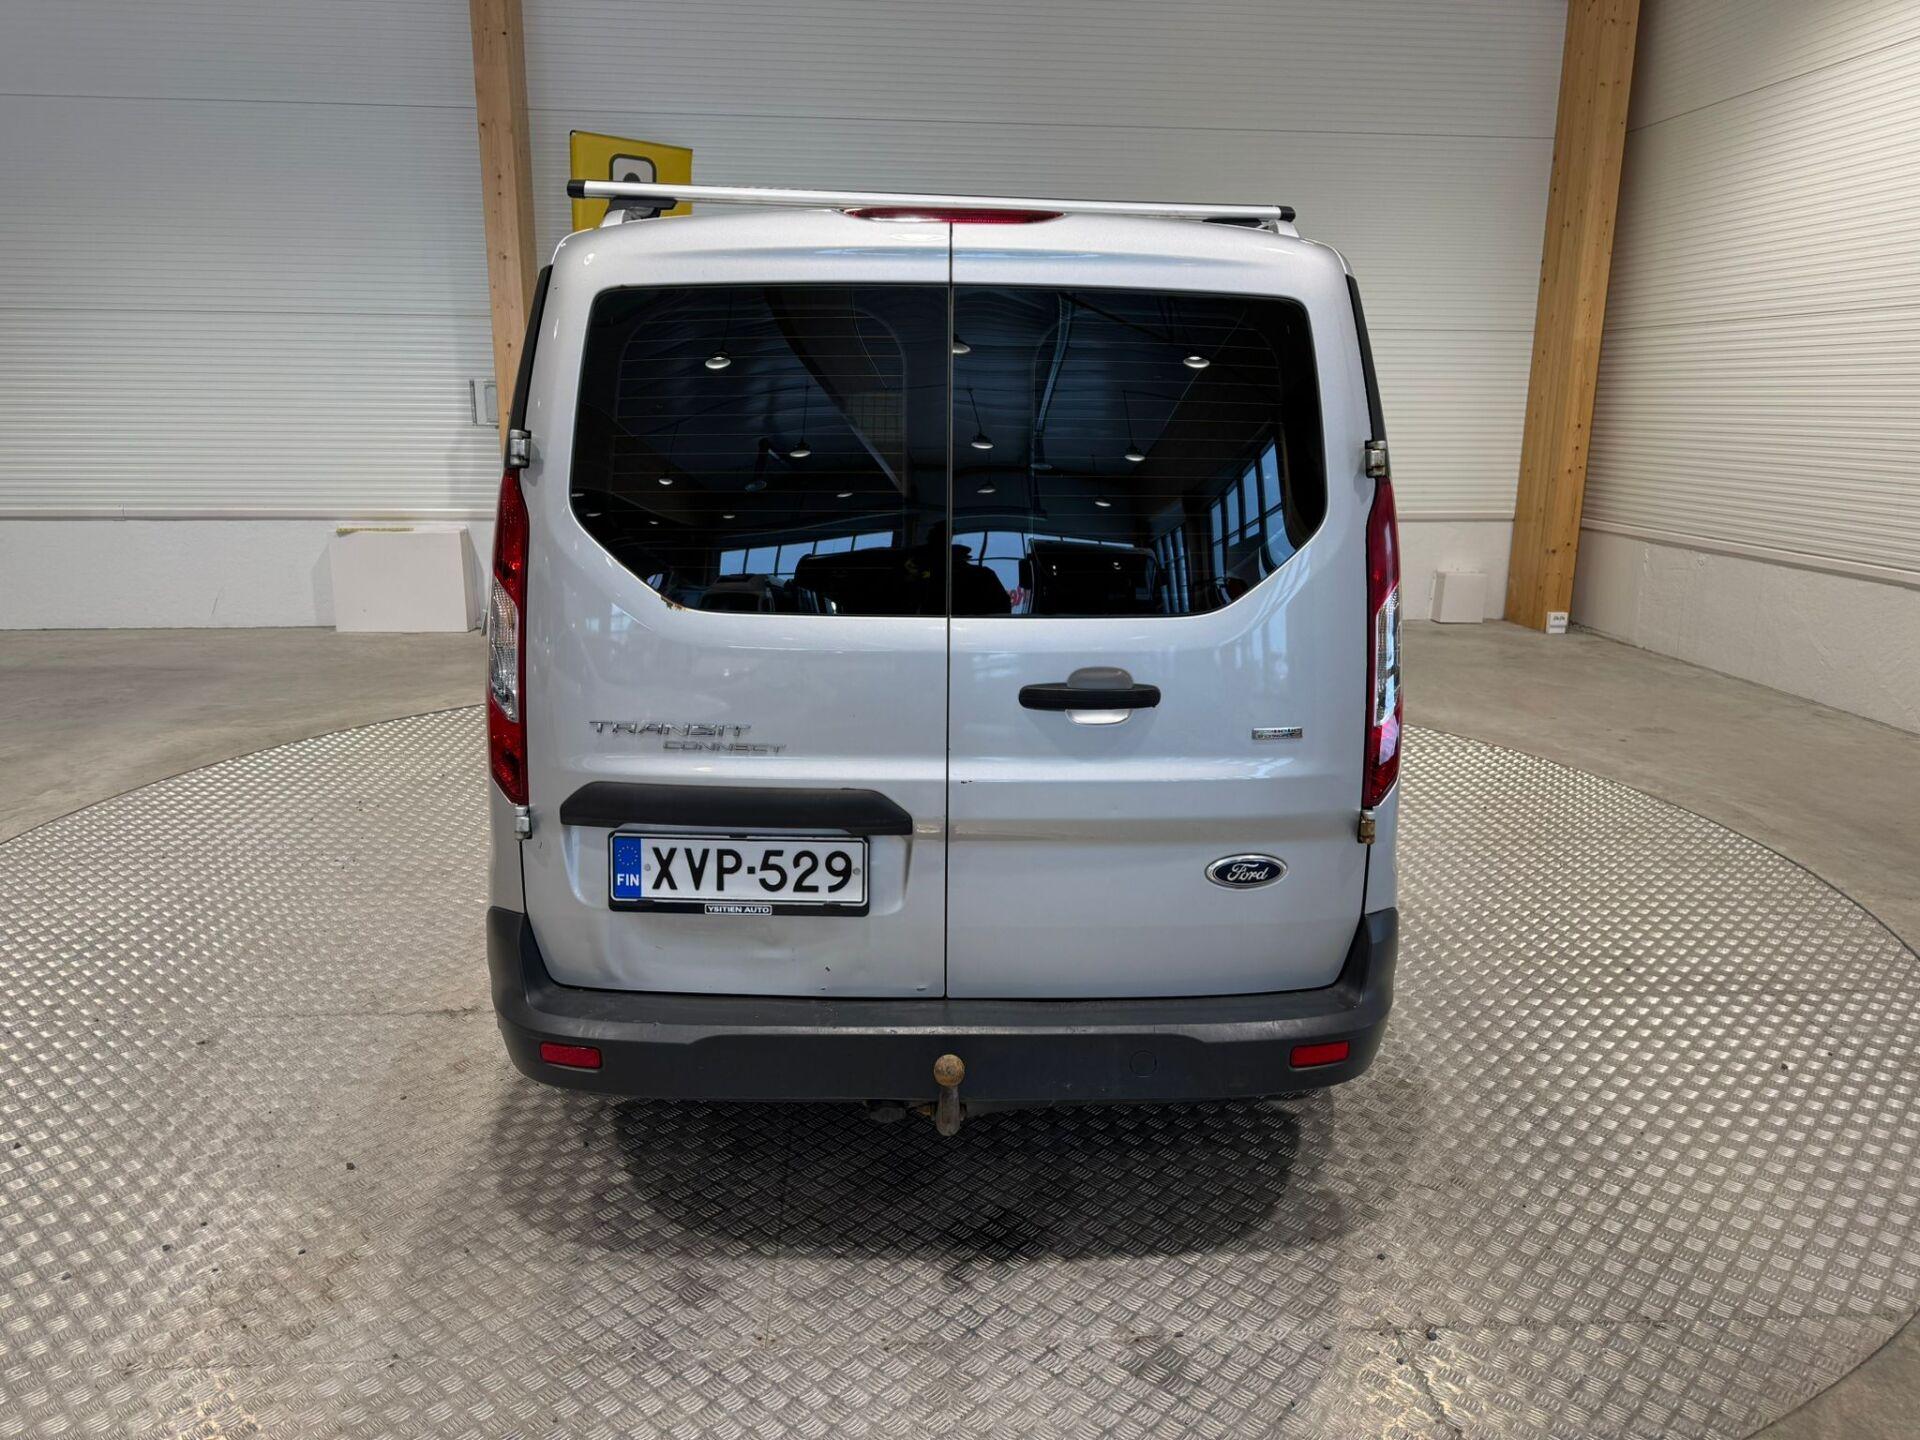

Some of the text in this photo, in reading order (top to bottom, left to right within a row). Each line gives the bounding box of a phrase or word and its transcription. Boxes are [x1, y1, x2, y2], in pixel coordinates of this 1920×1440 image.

[589, 721, 751, 737] TRANSIT
[663, 741, 787, 753] CONNECT
[652, 847, 851, 893] XVP-529
[1227, 863, 1268, 881] Ford
[616, 873, 640, 887] FIN
